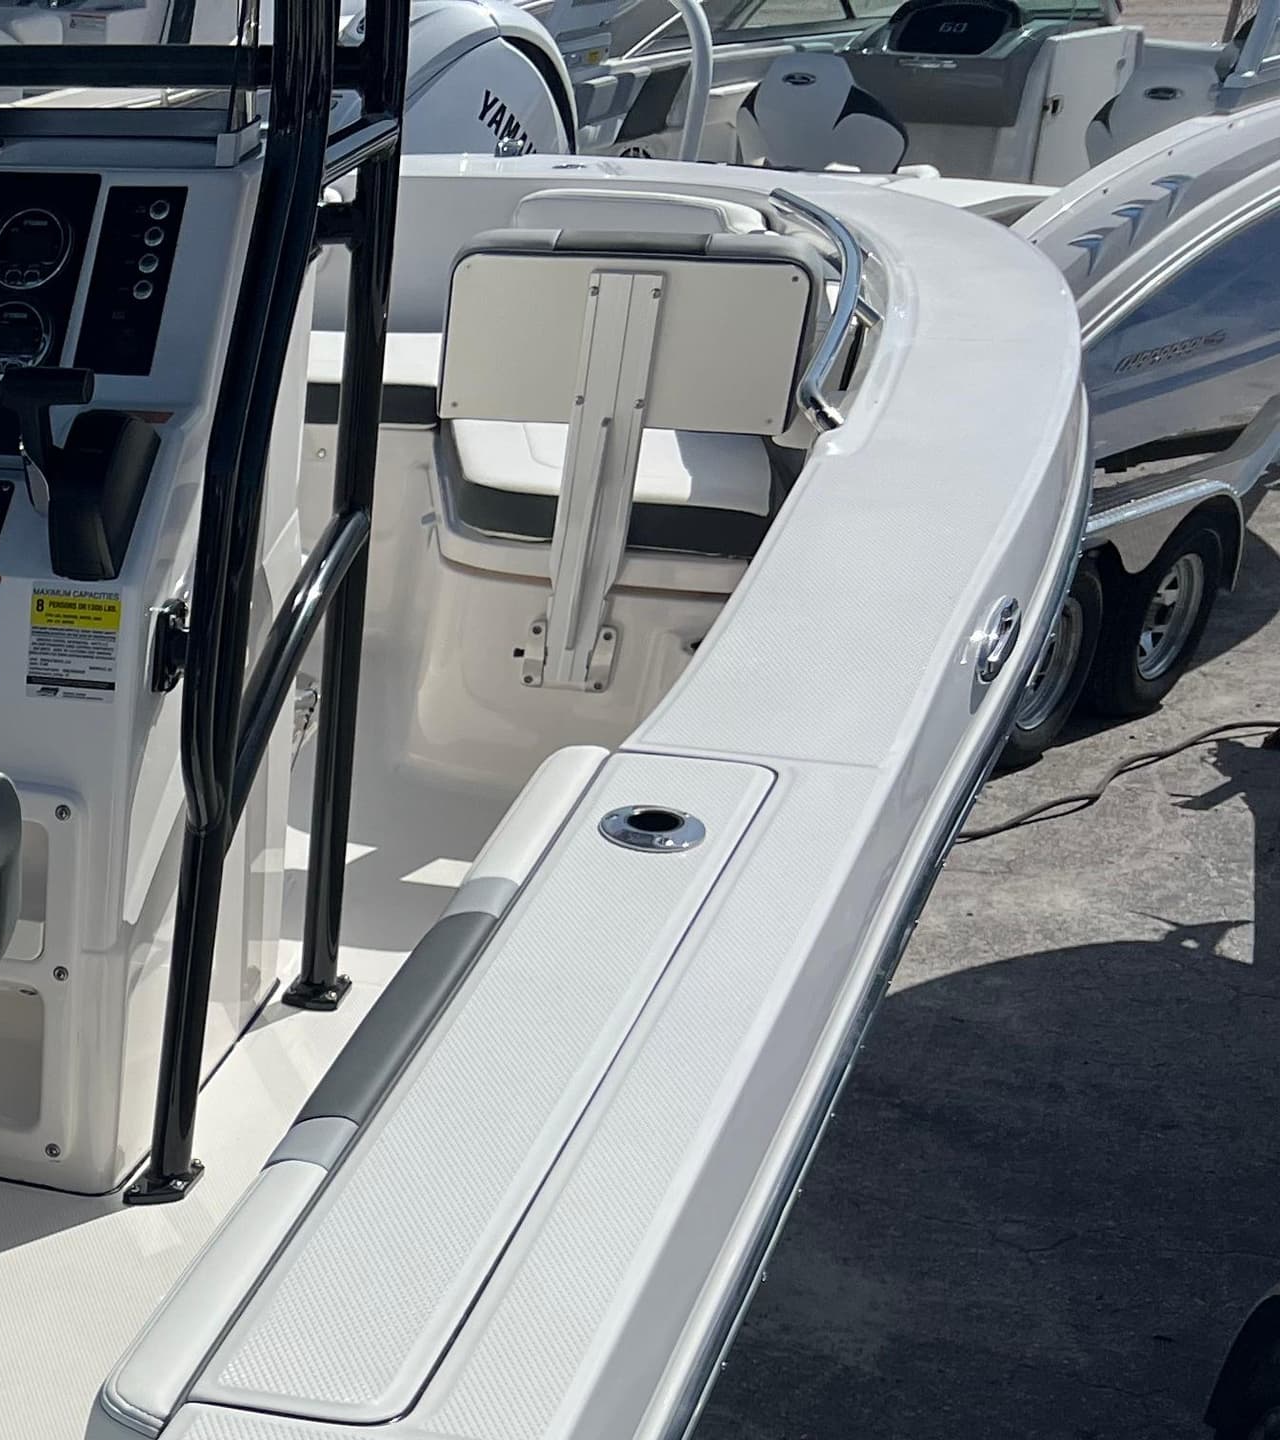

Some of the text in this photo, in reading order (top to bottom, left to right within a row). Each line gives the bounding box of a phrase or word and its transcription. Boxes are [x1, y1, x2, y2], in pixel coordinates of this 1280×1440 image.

[33, 587, 120, 601] MAXIMUM CAPACITIES
[36, 599, 44, 612] 8
